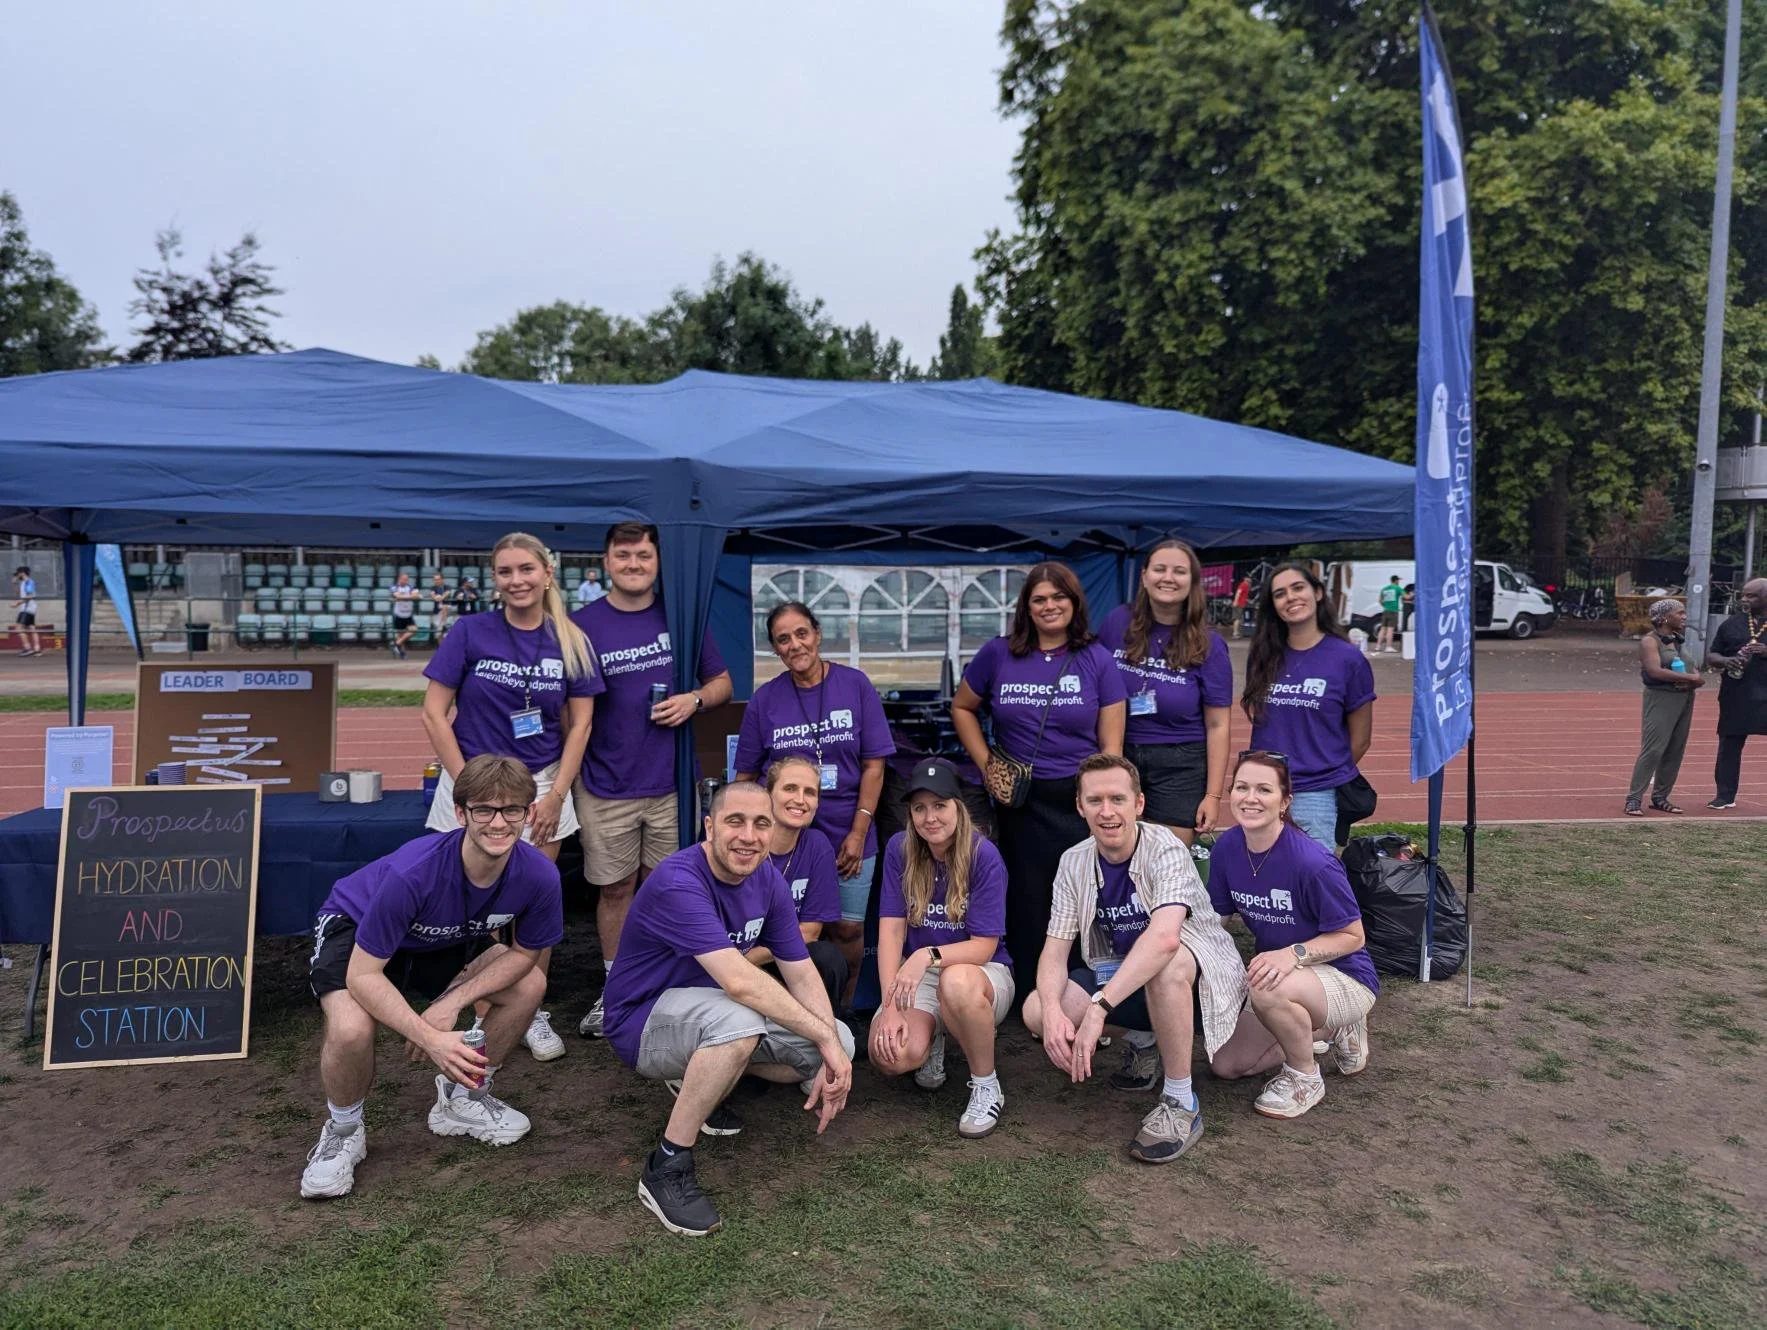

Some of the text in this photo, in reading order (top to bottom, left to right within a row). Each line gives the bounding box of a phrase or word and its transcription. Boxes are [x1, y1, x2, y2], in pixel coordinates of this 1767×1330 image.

[163, 672, 300, 689] LEADER BOARD
[76, 795, 248, 843] Prospectus
[78, 857, 244, 895] HYDRATION
[118, 909, 184, 943] AND
[58, 955, 247, 997] CELEBRATION
[75, 1005, 205, 1049] STATION
